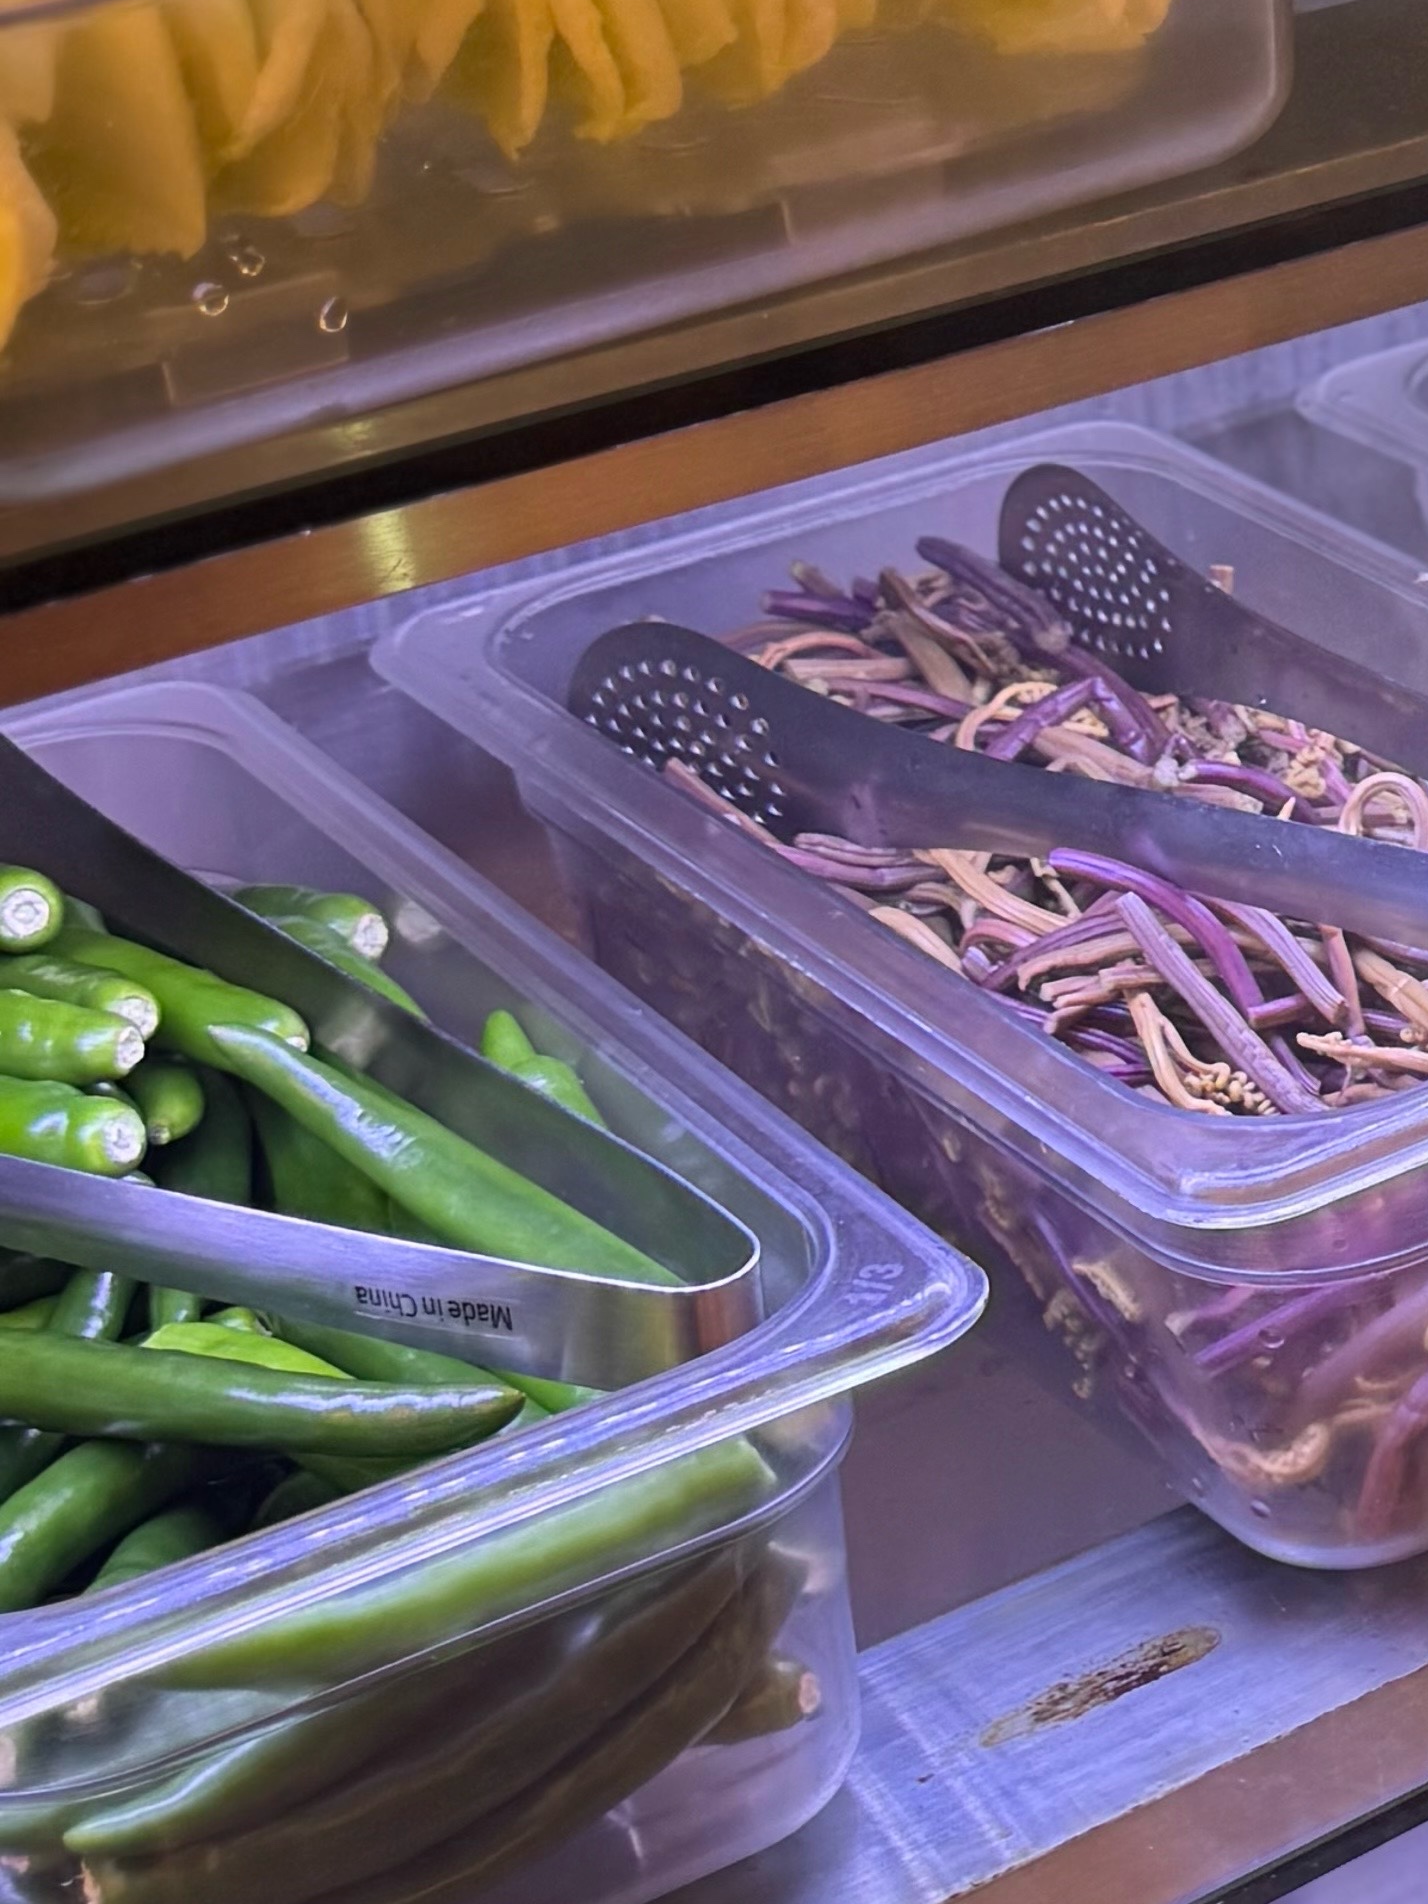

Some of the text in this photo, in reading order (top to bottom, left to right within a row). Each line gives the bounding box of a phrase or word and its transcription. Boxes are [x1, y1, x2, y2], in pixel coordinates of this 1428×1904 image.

[355, 1285, 513, 1331] Made in China
